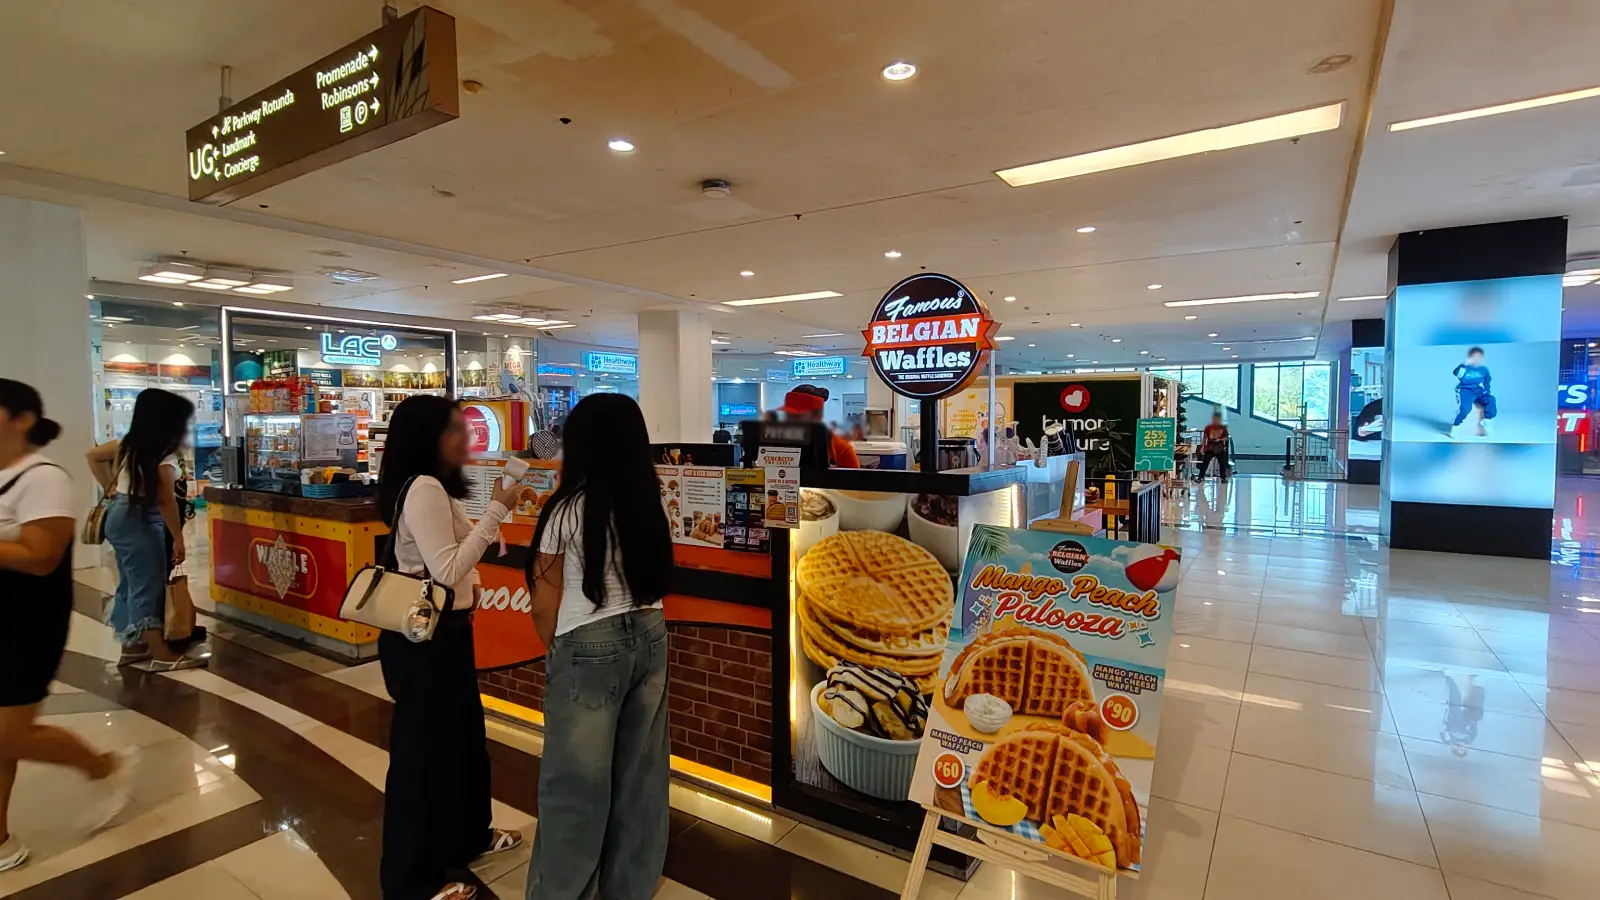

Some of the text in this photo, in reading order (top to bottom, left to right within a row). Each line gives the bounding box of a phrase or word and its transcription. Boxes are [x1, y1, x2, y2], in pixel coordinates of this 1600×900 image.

[316, 51, 369, 90] Promenade
[321, 78, 370, 111] Robinsons
[232, 88, 295, 132] Parkway Rotunda
[222, 130, 256, 158] Landmark
[189, 143, 214, 180] UG
[223, 154, 260, 178] Concierge
[884, 295, 963, 322] Famous
[871, 317, 980, 344] BELGIAN
[321, 333, 381, 358] LAC
[603, 355, 635, 367] Healthway
[807, 360, 842, 369] Healthway
[879, 346, 971, 371] Waffles
[211, 380, 247, 393] LC
[1144, 429, 1168, 440] 25%
[1144, 439, 1167, 448] OFF
[1052, 551, 1087, 560] BELGIAN
[1053, 558, 1083, 567] Waffles
[972, 565, 1158, 617] Mango Peach
[995, 592, 1124, 637] Palooza
[1093, 672, 1157, 690] CREAM CHEESE
[1095, 664, 1157, 683] MANGO PEACH
[1107, 681, 1140, 694] WAFFLE
[931, 730, 982, 750] MANGO PEACH
[941, 740, 969, 753] WAFFLE
